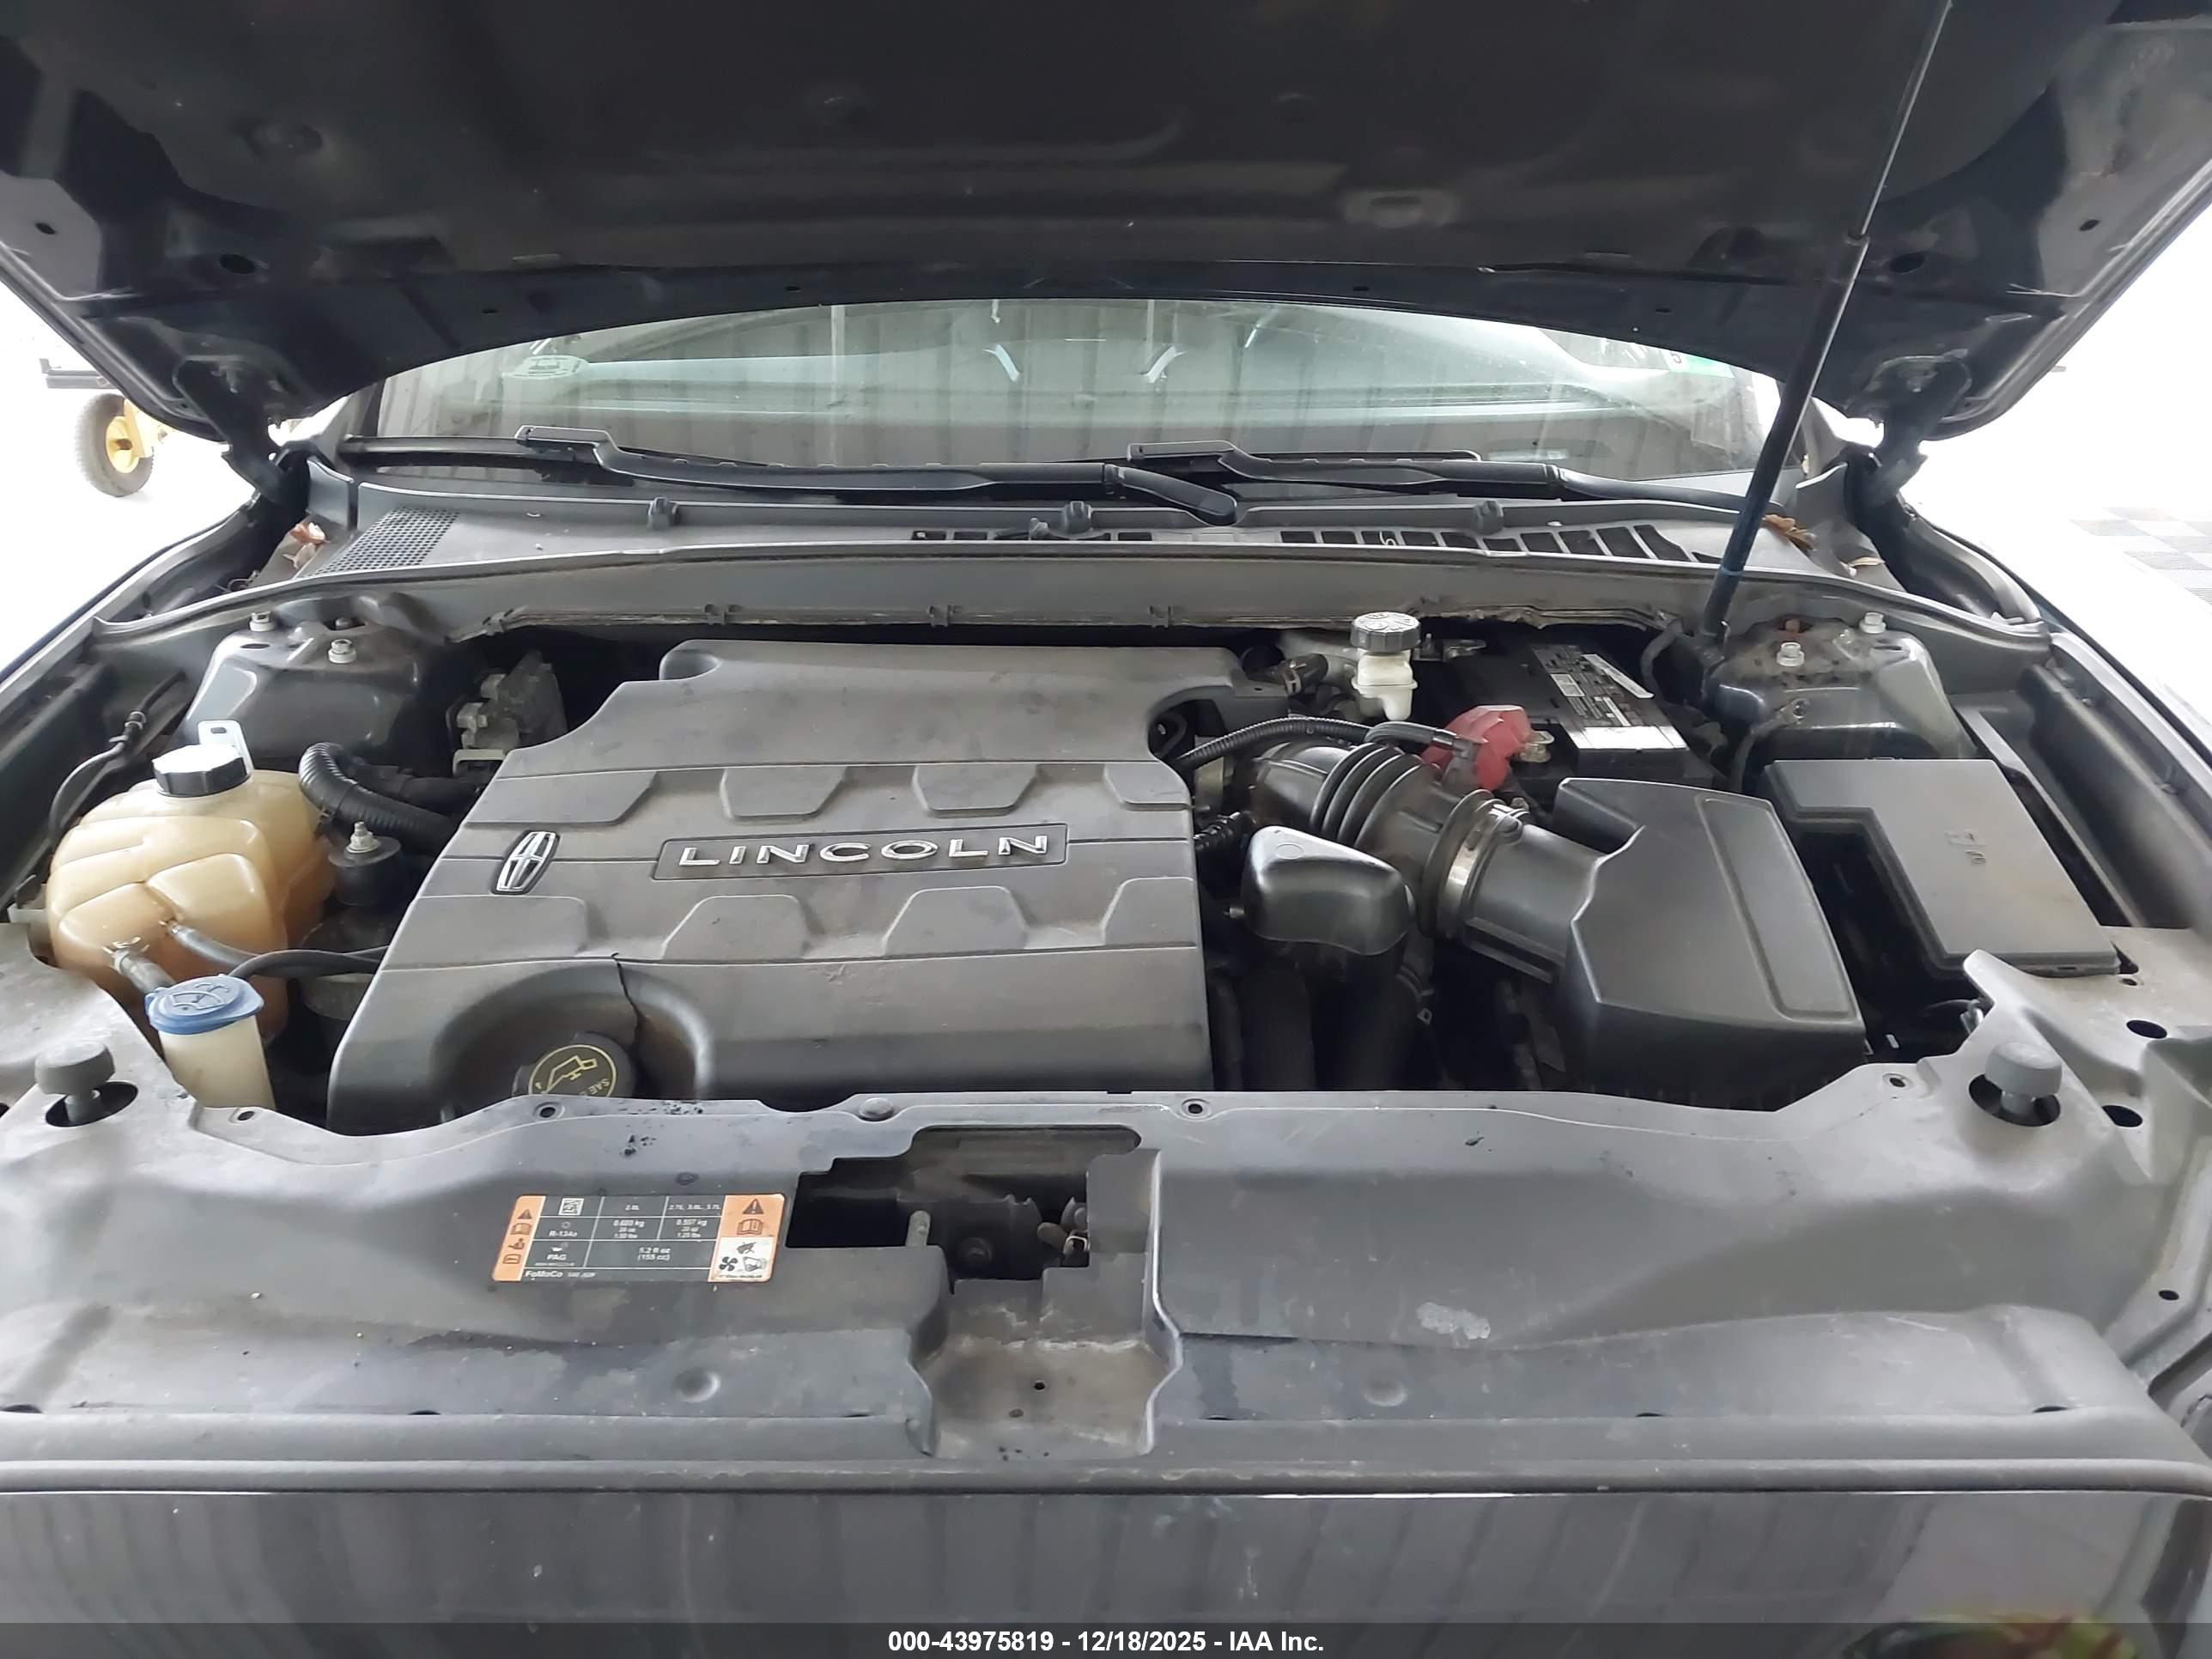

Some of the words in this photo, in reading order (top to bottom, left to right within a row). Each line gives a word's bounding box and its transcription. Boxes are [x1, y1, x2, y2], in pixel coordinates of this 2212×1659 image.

[678, 835, 1048, 866] LINCOLN
[587, 1078, 611, 1096] SAE
[635, 1219, 645, 1228] kg
[525, 1270, 563, 1279] FoMoCo
